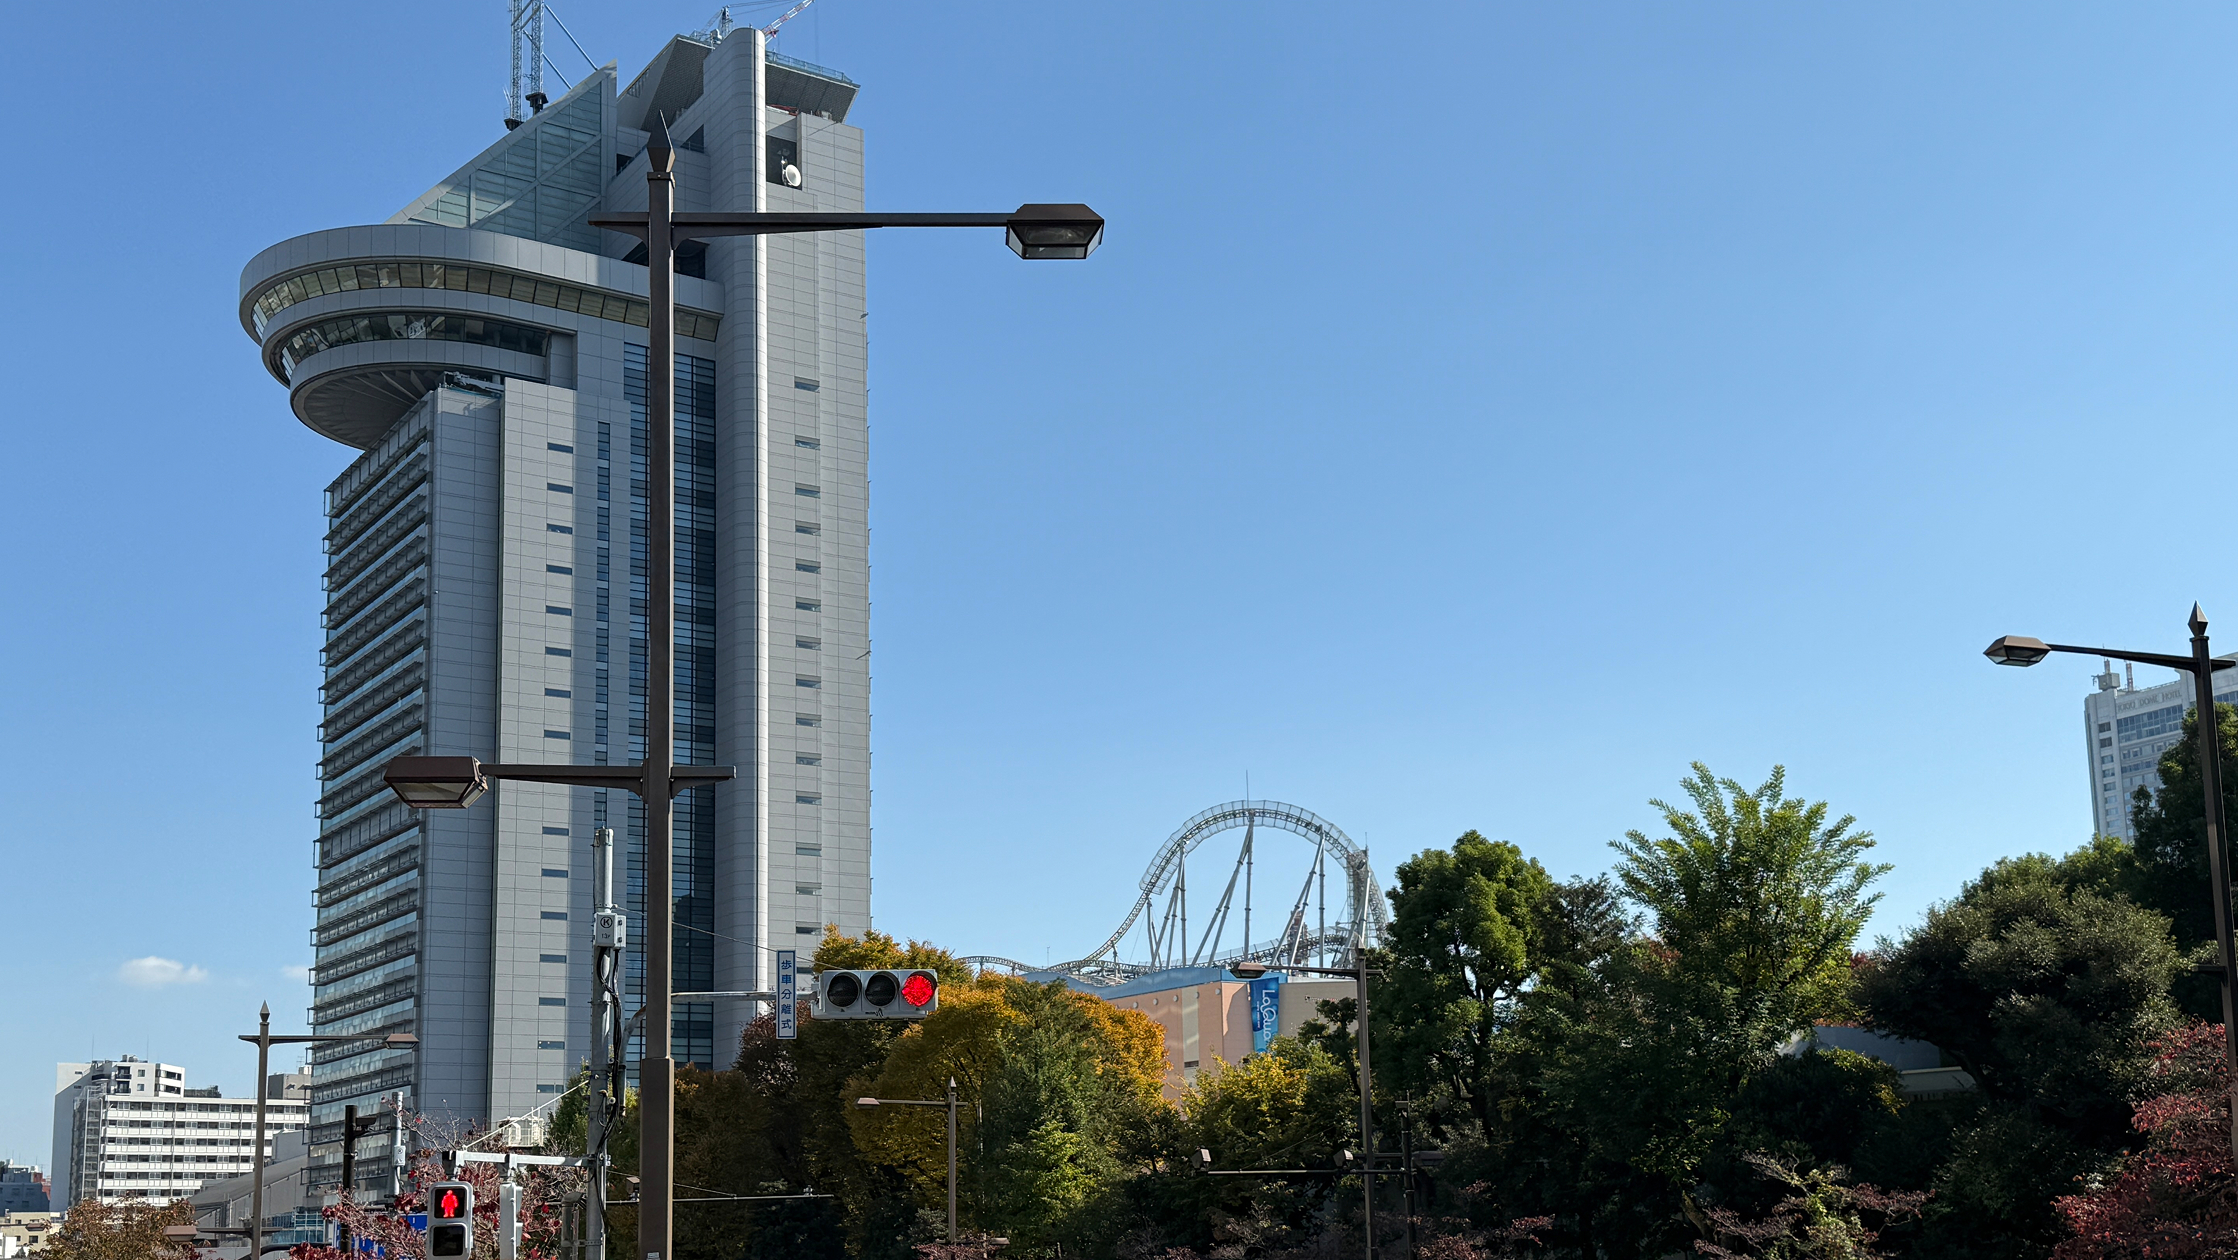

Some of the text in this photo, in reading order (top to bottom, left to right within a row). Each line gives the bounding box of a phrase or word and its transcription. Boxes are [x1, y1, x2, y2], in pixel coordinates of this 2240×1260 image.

[781, 960, 792, 1029] 歩車分離式
[1261, 989, 1276, 1041] LaQua
